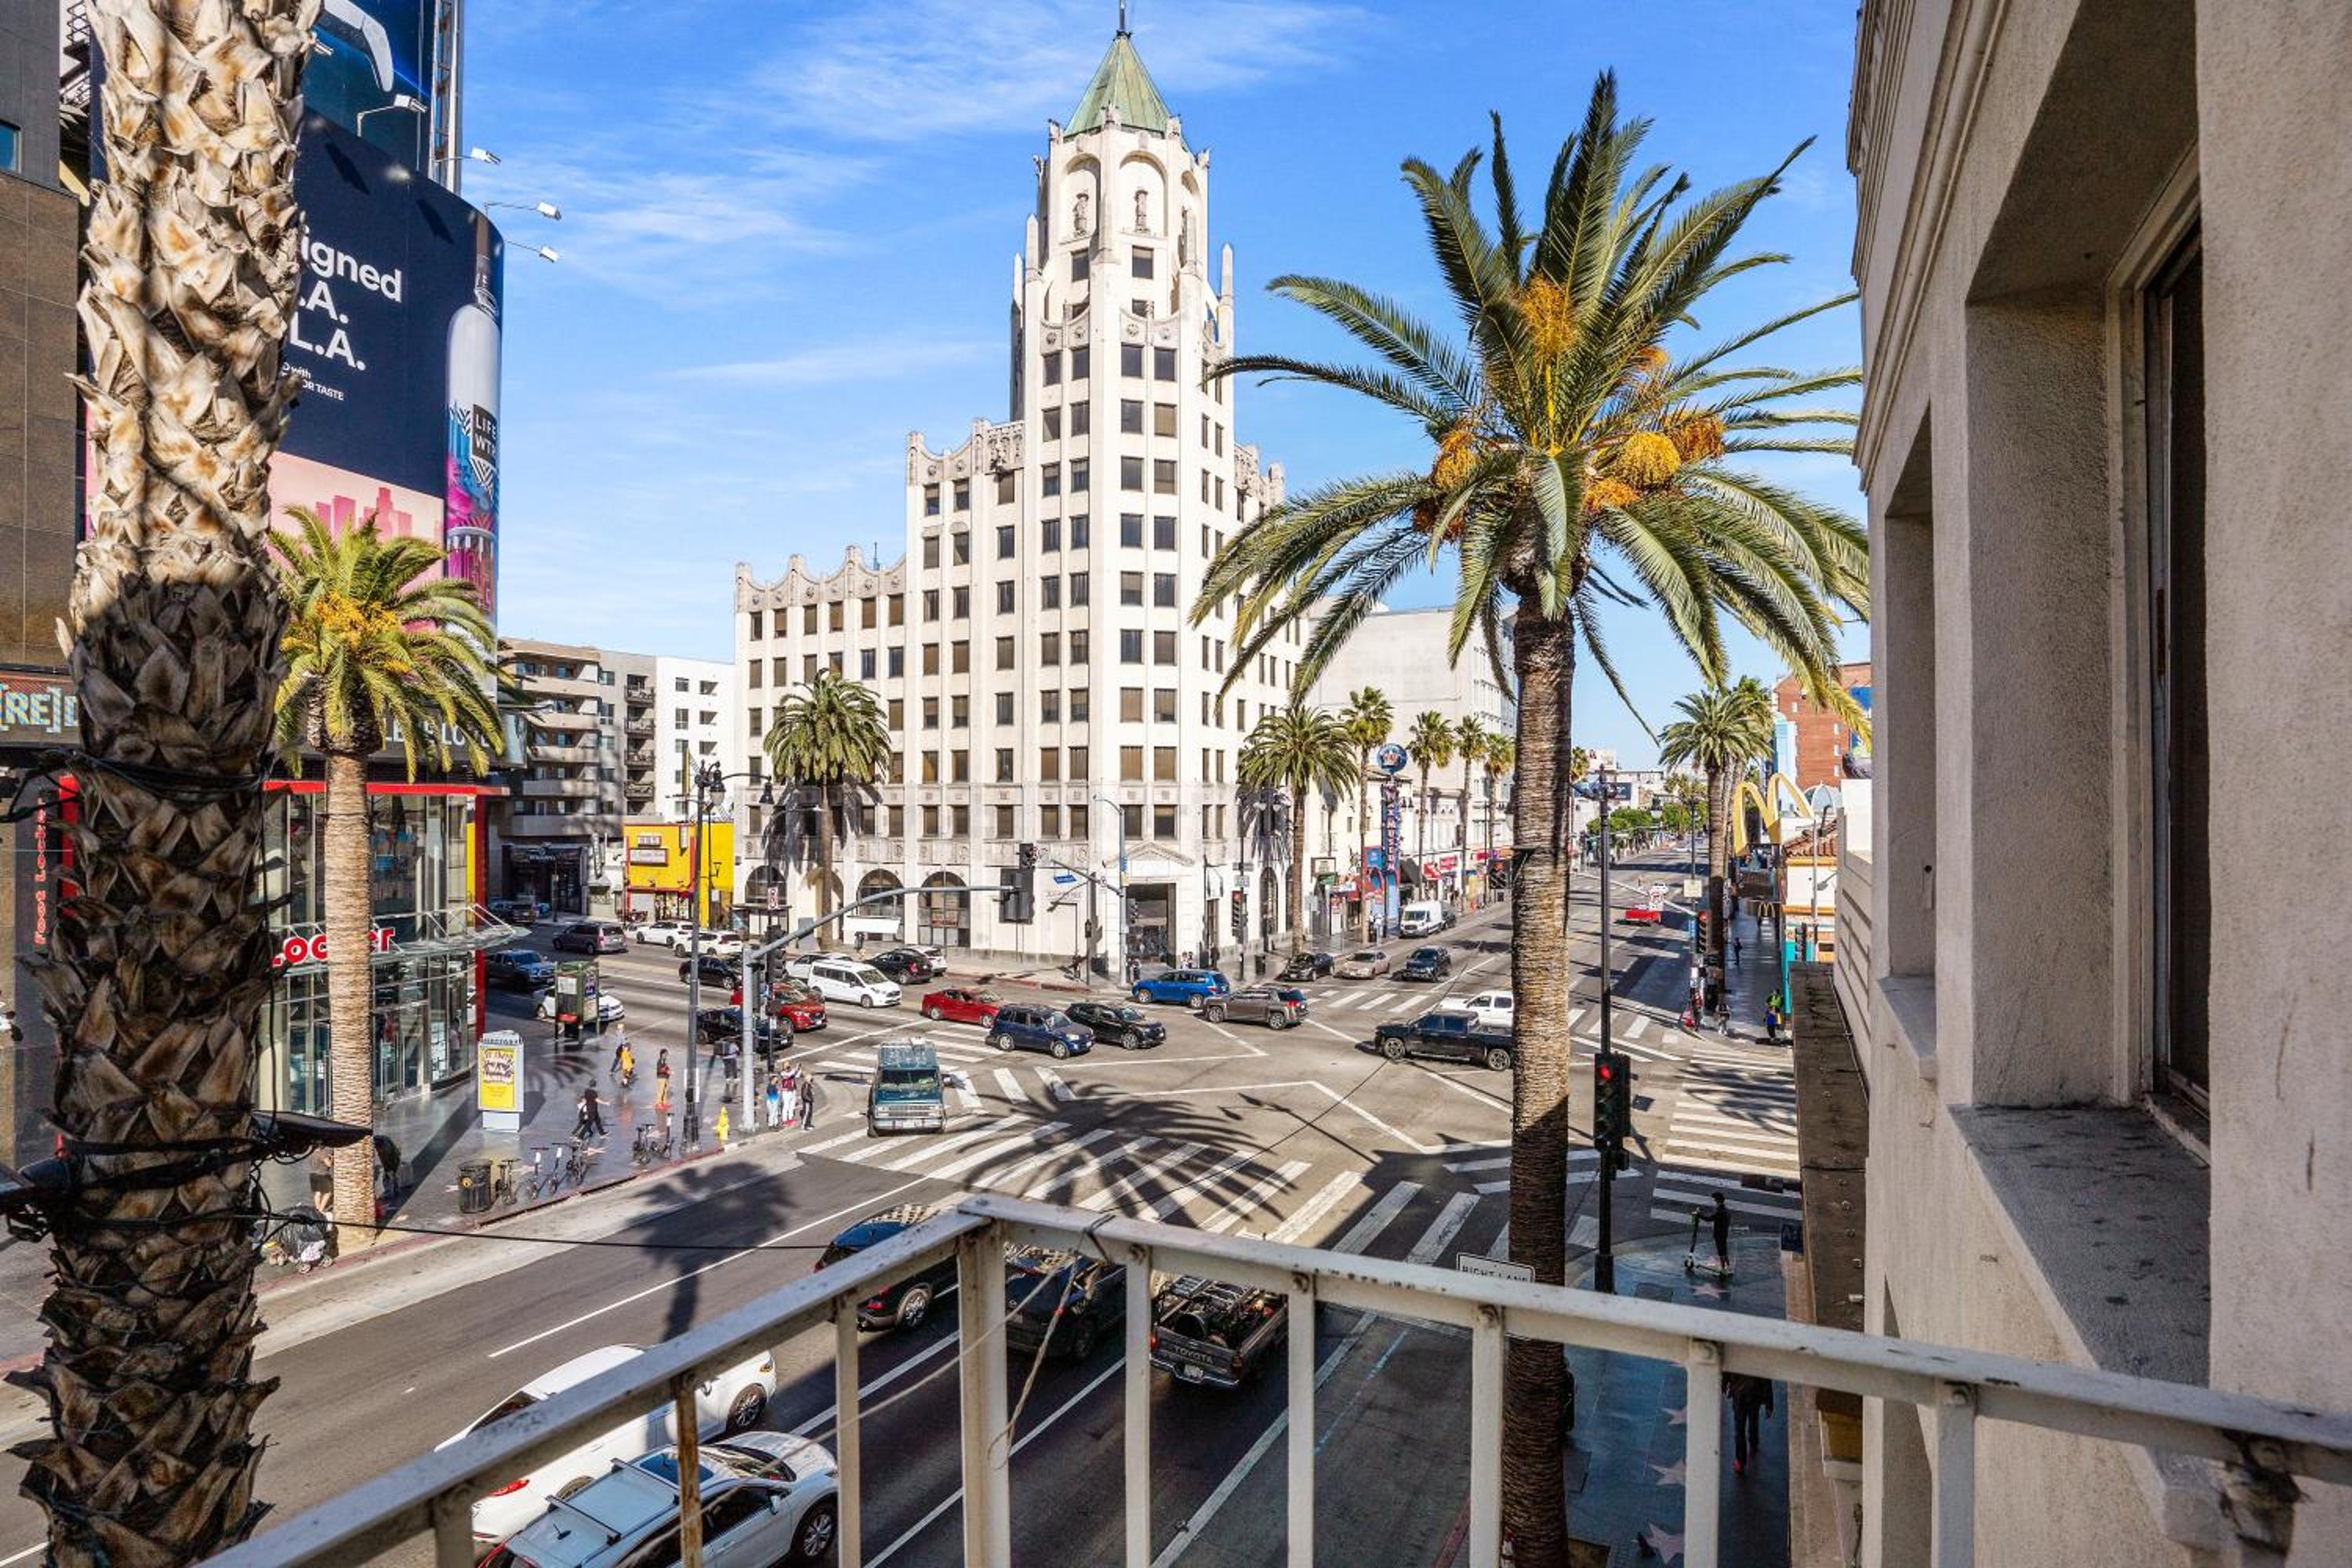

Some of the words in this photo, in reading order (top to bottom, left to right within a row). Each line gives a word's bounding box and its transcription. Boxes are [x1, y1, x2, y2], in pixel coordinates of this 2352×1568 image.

[301, 224, 402, 303] igned
[299, 280, 349, 324] .A.
[290, 311, 366, 371] L.A.
[315, 383, 344, 401] TASTE
[475, 414, 496, 440] LIFE
[1174, 1345, 1214, 1364] TOYOTA
